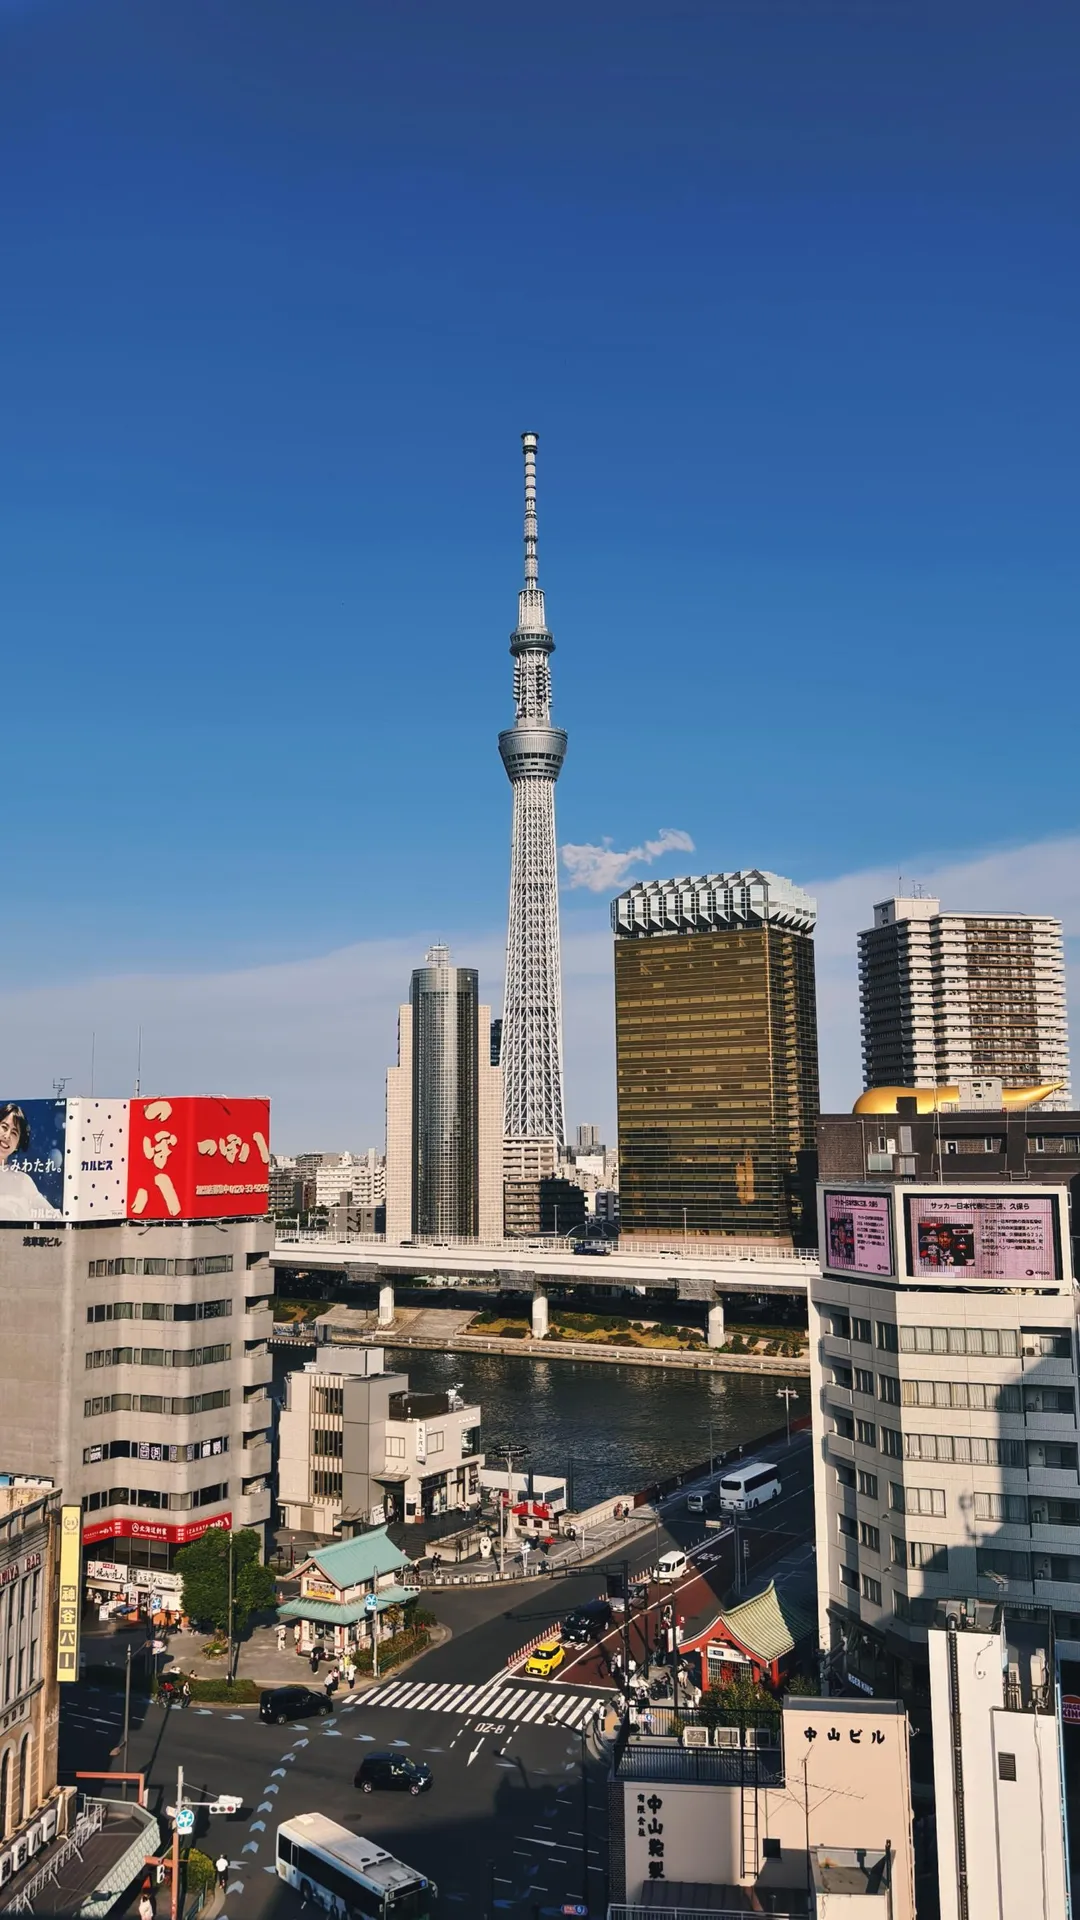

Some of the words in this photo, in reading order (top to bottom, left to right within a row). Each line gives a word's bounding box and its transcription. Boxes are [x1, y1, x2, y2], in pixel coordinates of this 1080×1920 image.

[81, 1160, 113, 1171] カルピス
[24, 1553, 41, 1572] BAR
[60, 1586, 76, 1668] 神谷バー
[804, 1726, 885, 1744] 中山ビル
